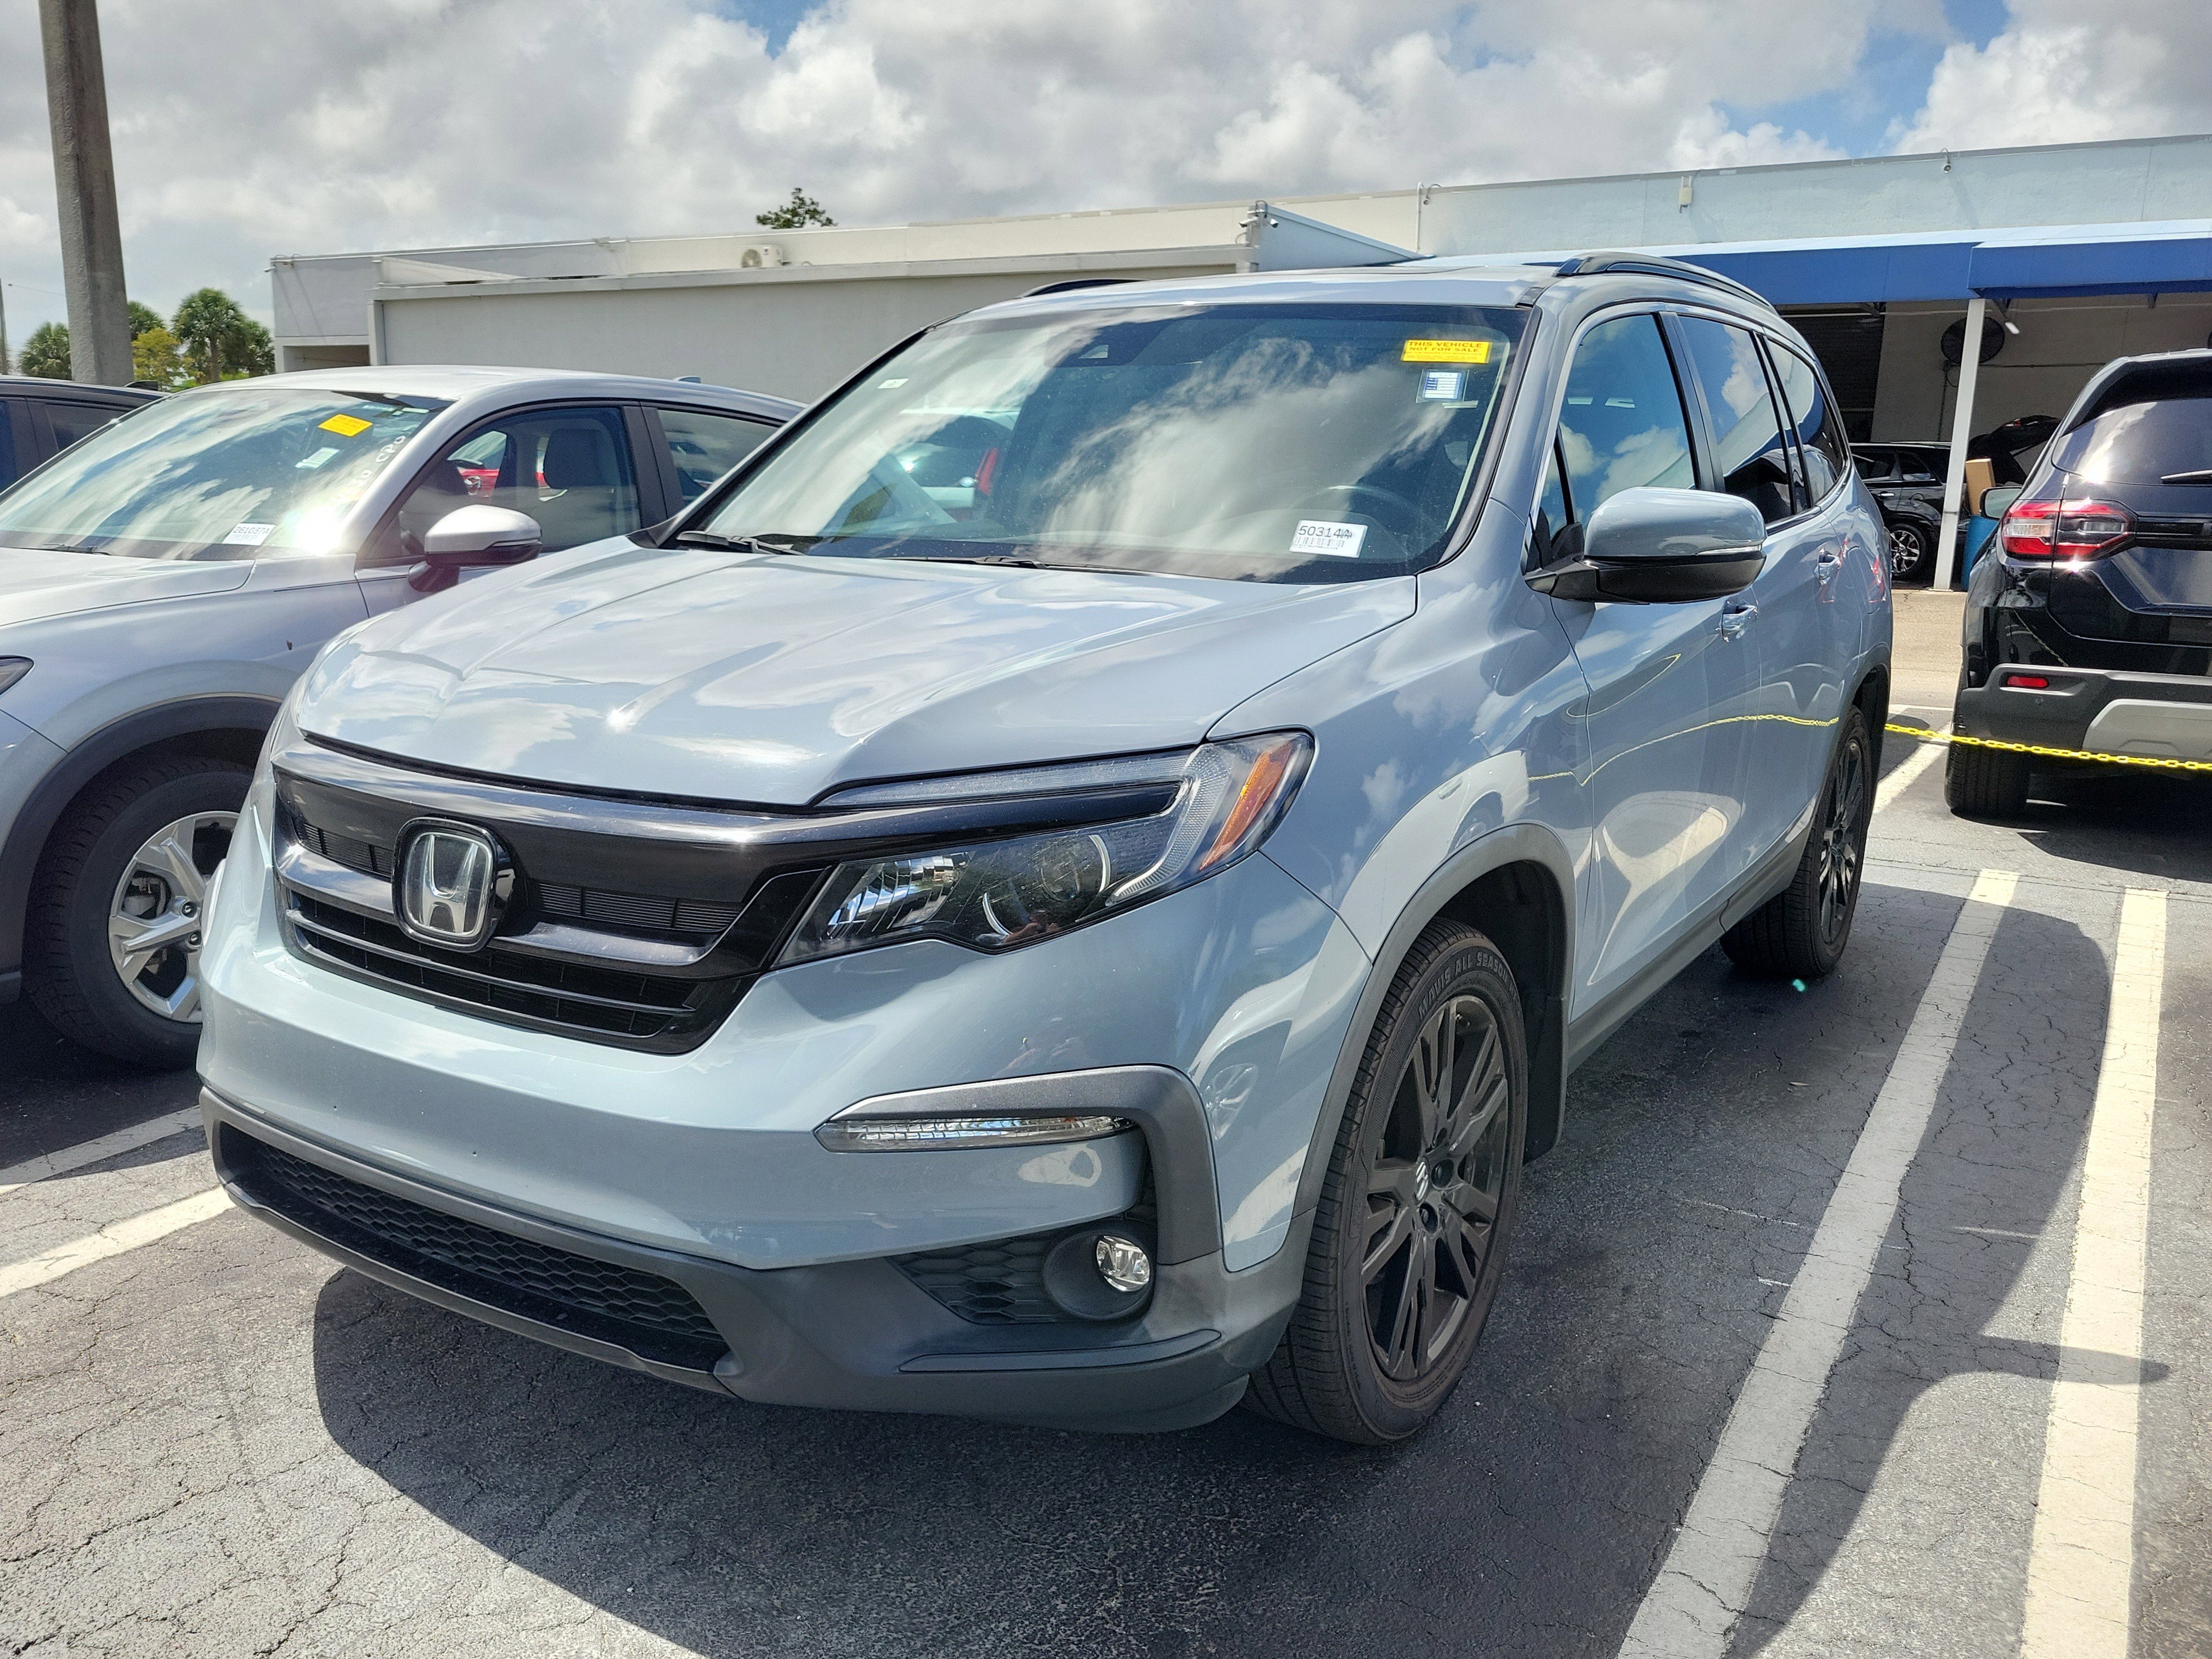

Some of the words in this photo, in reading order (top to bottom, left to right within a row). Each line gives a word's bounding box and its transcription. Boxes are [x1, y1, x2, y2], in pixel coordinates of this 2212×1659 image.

[1418, 967, 1451, 1023] MAVIS
[1455, 954, 1473, 977] ALL
[1476, 951, 1508, 983] SEASON
